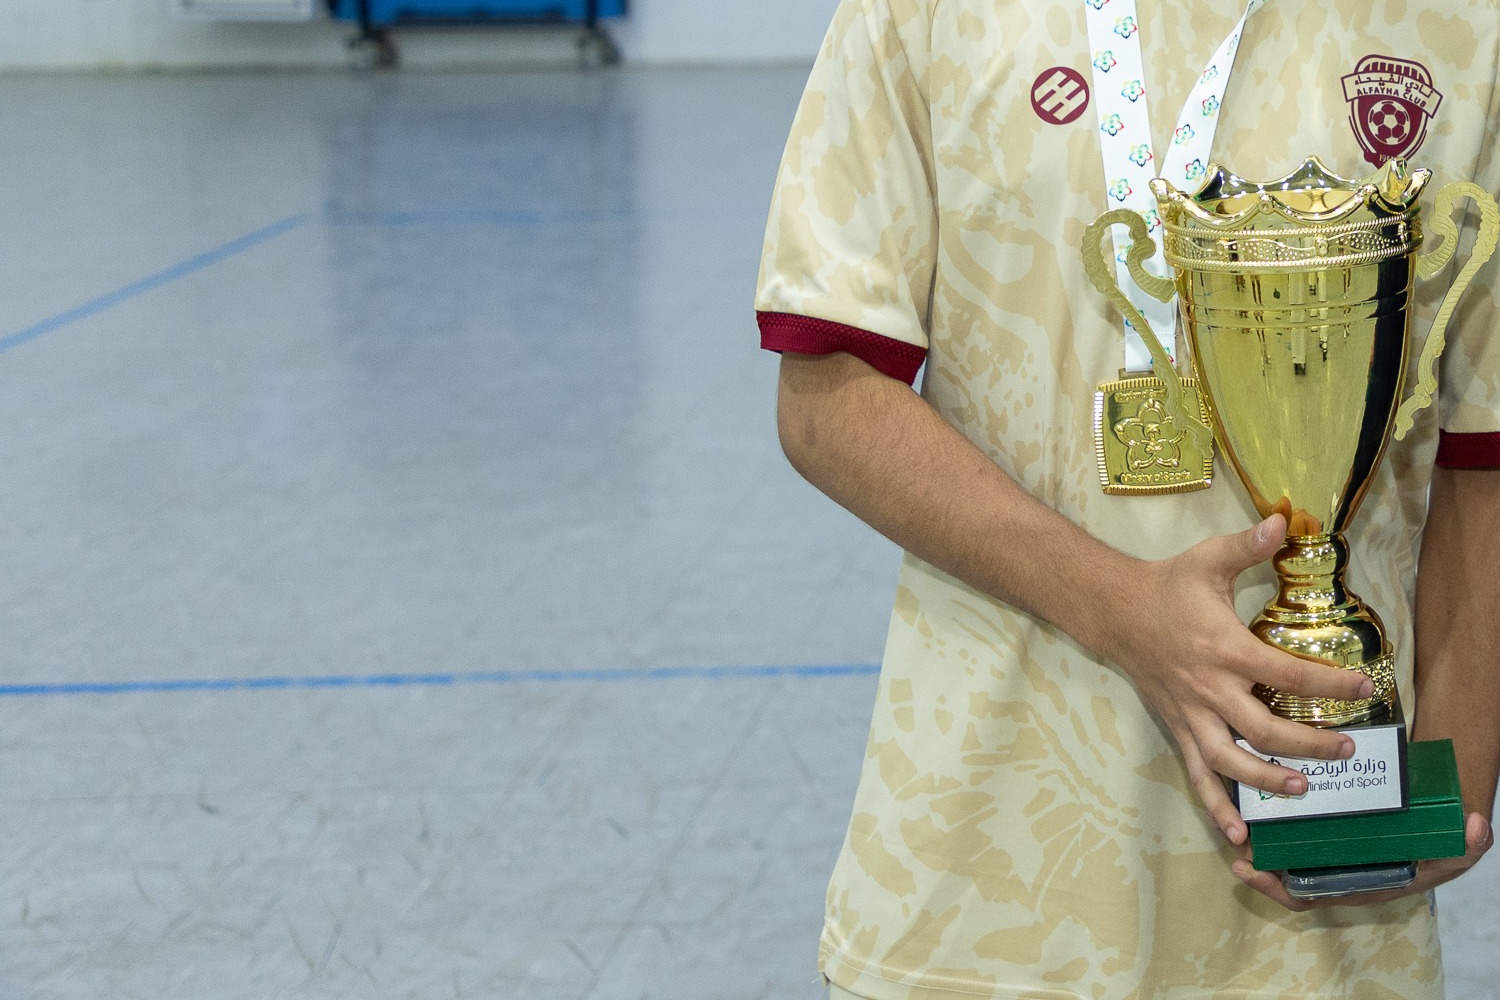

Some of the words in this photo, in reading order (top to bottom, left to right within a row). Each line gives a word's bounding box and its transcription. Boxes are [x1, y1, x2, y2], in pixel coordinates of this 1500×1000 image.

[1357, 86, 1399, 96] ALFAYHA
[1403, 92, 1427, 108] CLUB
[1301, 760, 1348, 777] الرياضة
[1353, 758, 1386, 774] وزارة
[1343, 777, 1355, 789] of
[1357, 775, 1387, 788] Sport
